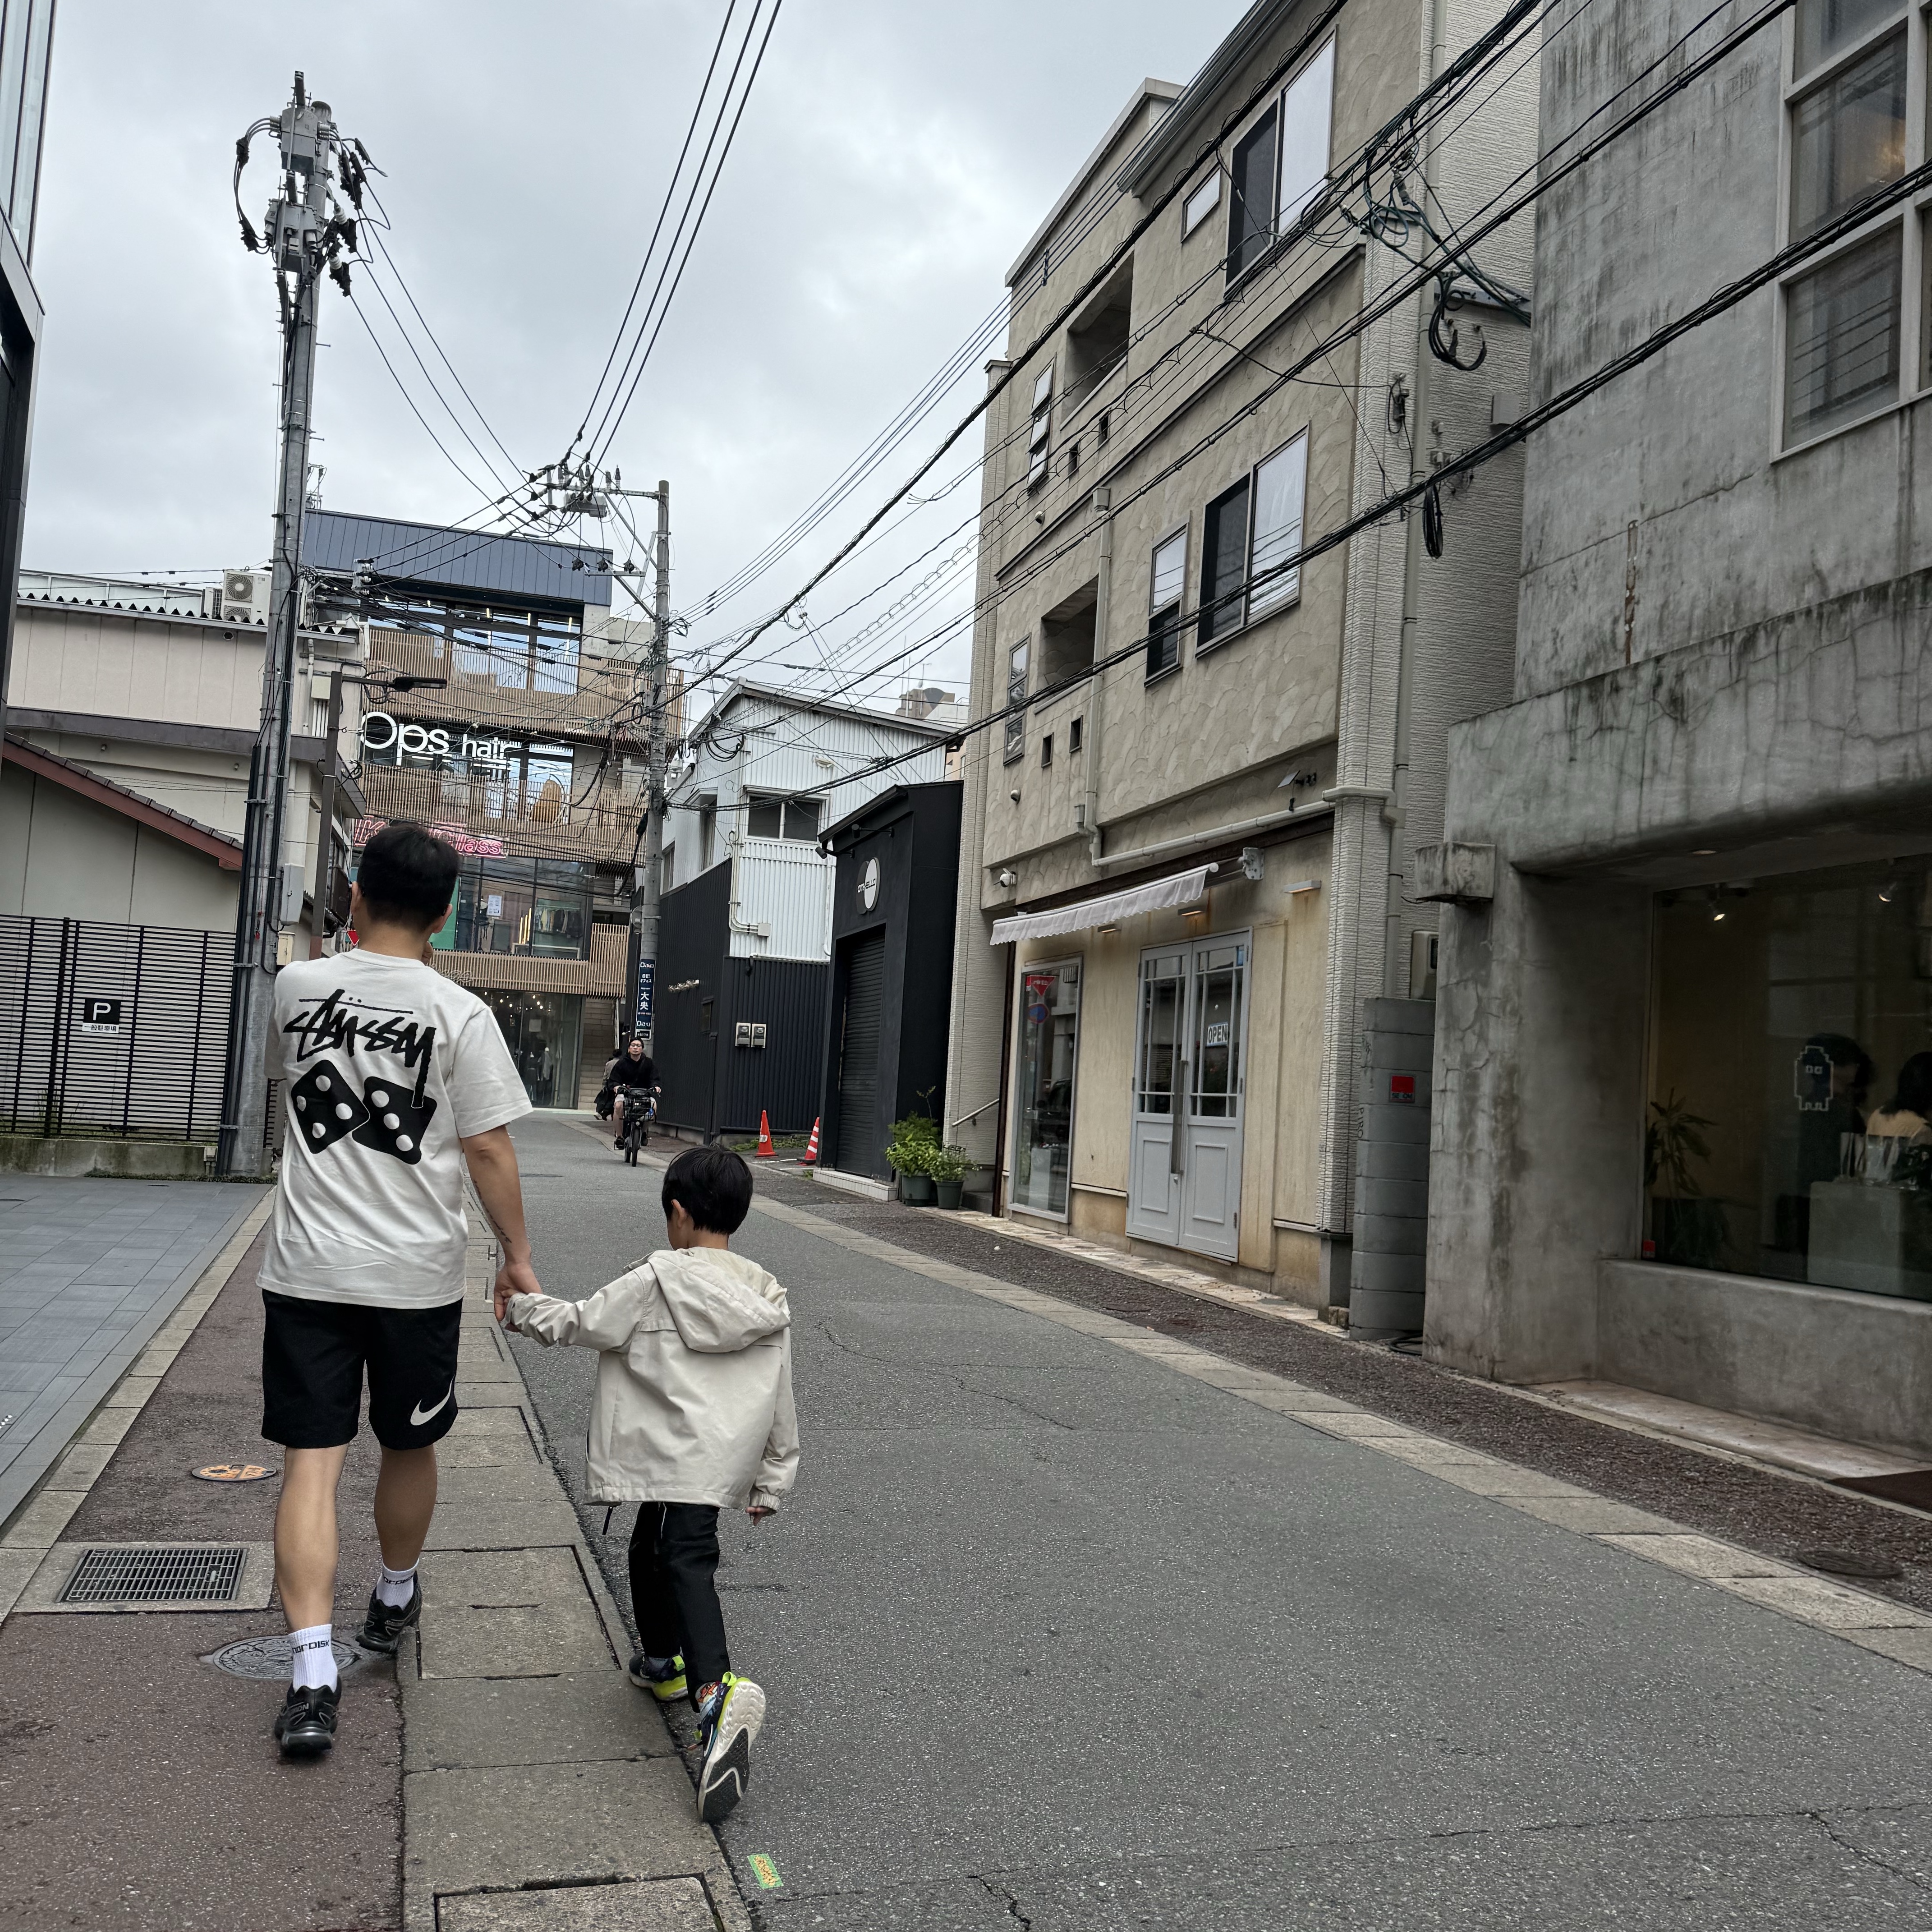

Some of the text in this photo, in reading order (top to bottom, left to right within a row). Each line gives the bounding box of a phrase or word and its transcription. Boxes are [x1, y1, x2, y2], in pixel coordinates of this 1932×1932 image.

[360, 712, 517, 766] Ops hair
[93, 1002, 111, 1021] P
[1209, 1024, 1227, 1043] OPEN
